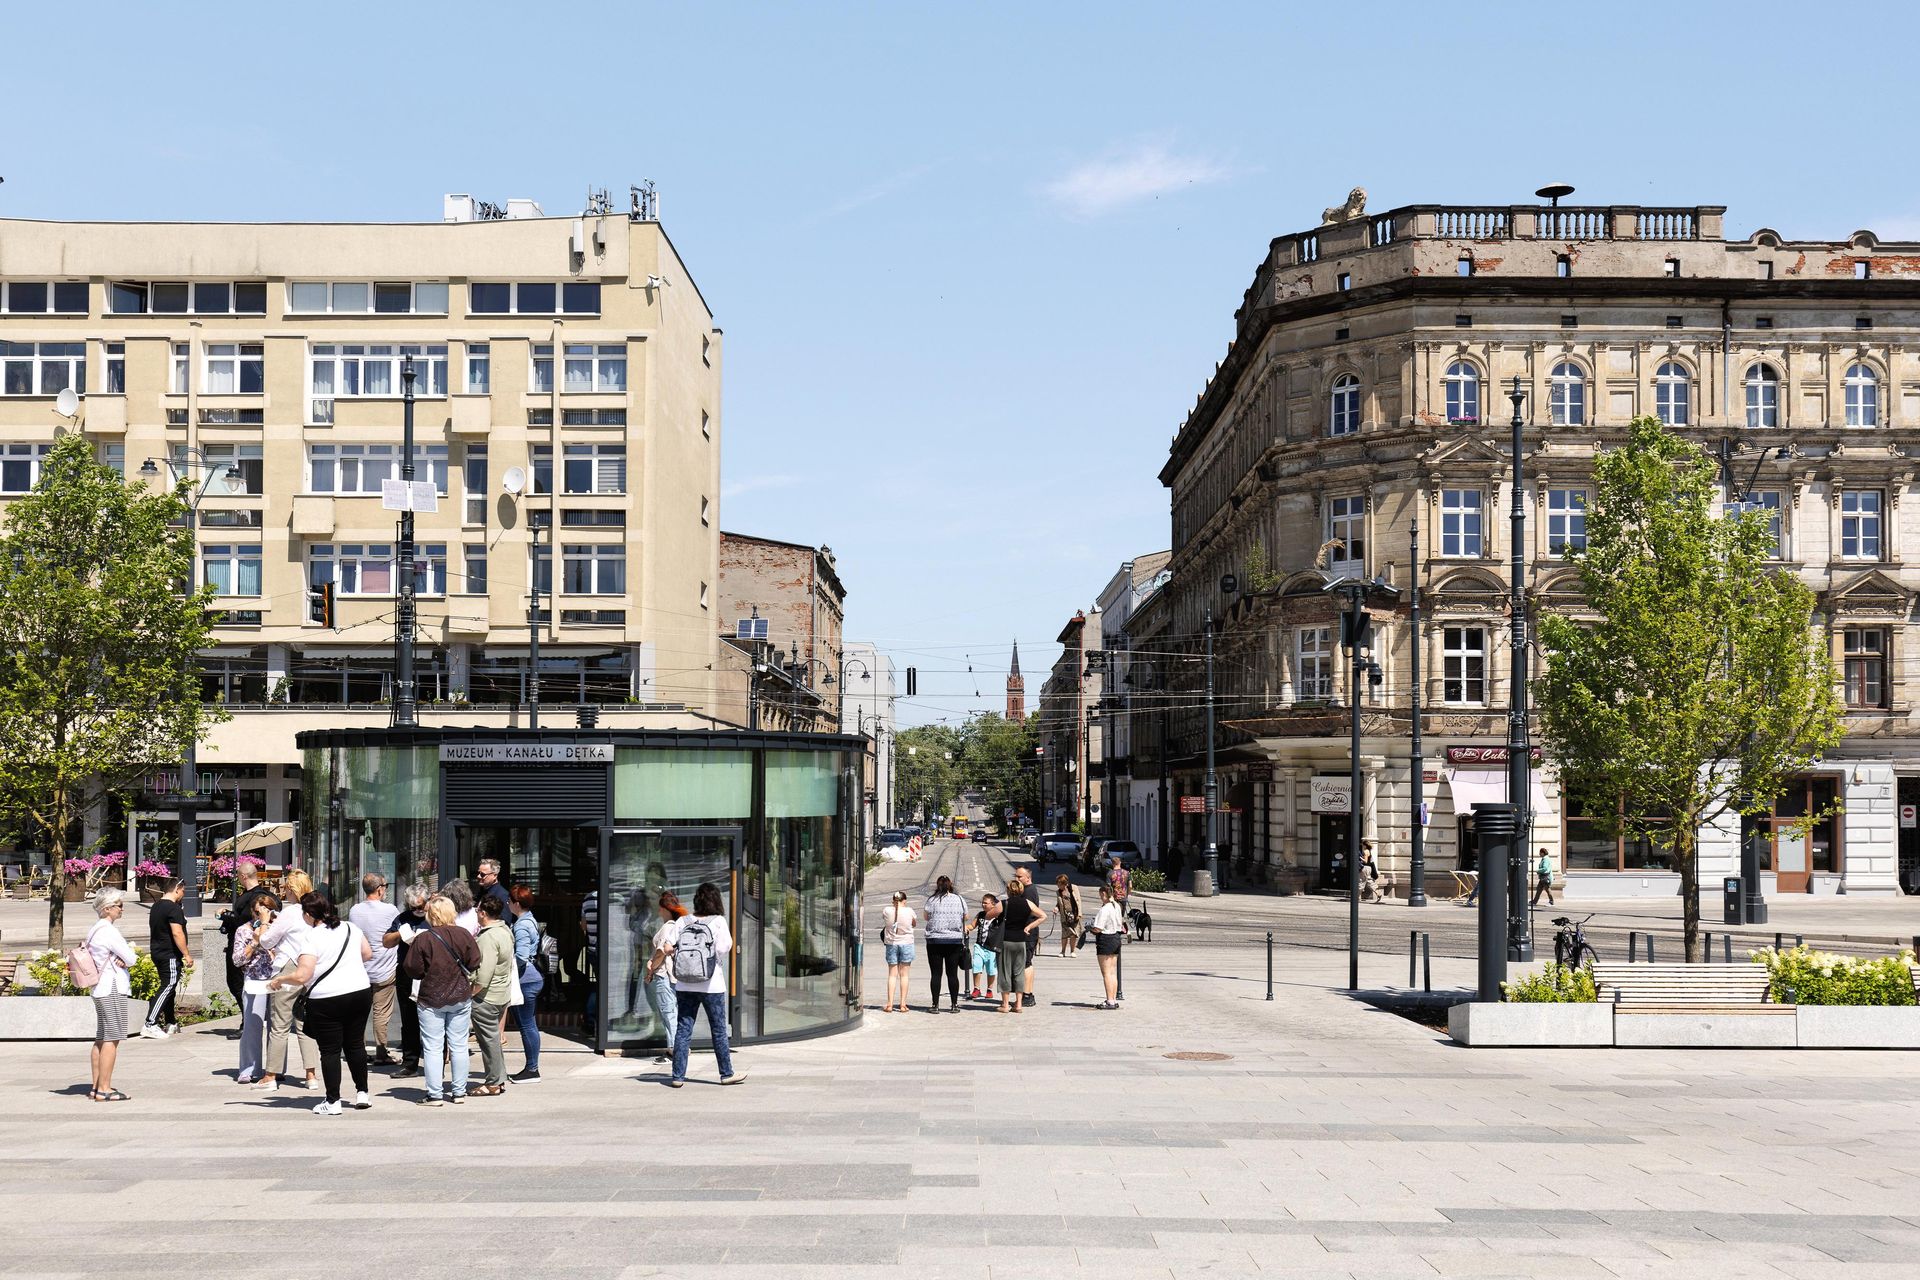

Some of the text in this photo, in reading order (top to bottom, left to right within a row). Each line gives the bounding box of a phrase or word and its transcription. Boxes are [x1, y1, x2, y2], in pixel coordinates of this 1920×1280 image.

[446, 747, 605, 760] MUZEUM KANAŁU DĘTKA
[1481, 749, 1541, 760] Cukiia
